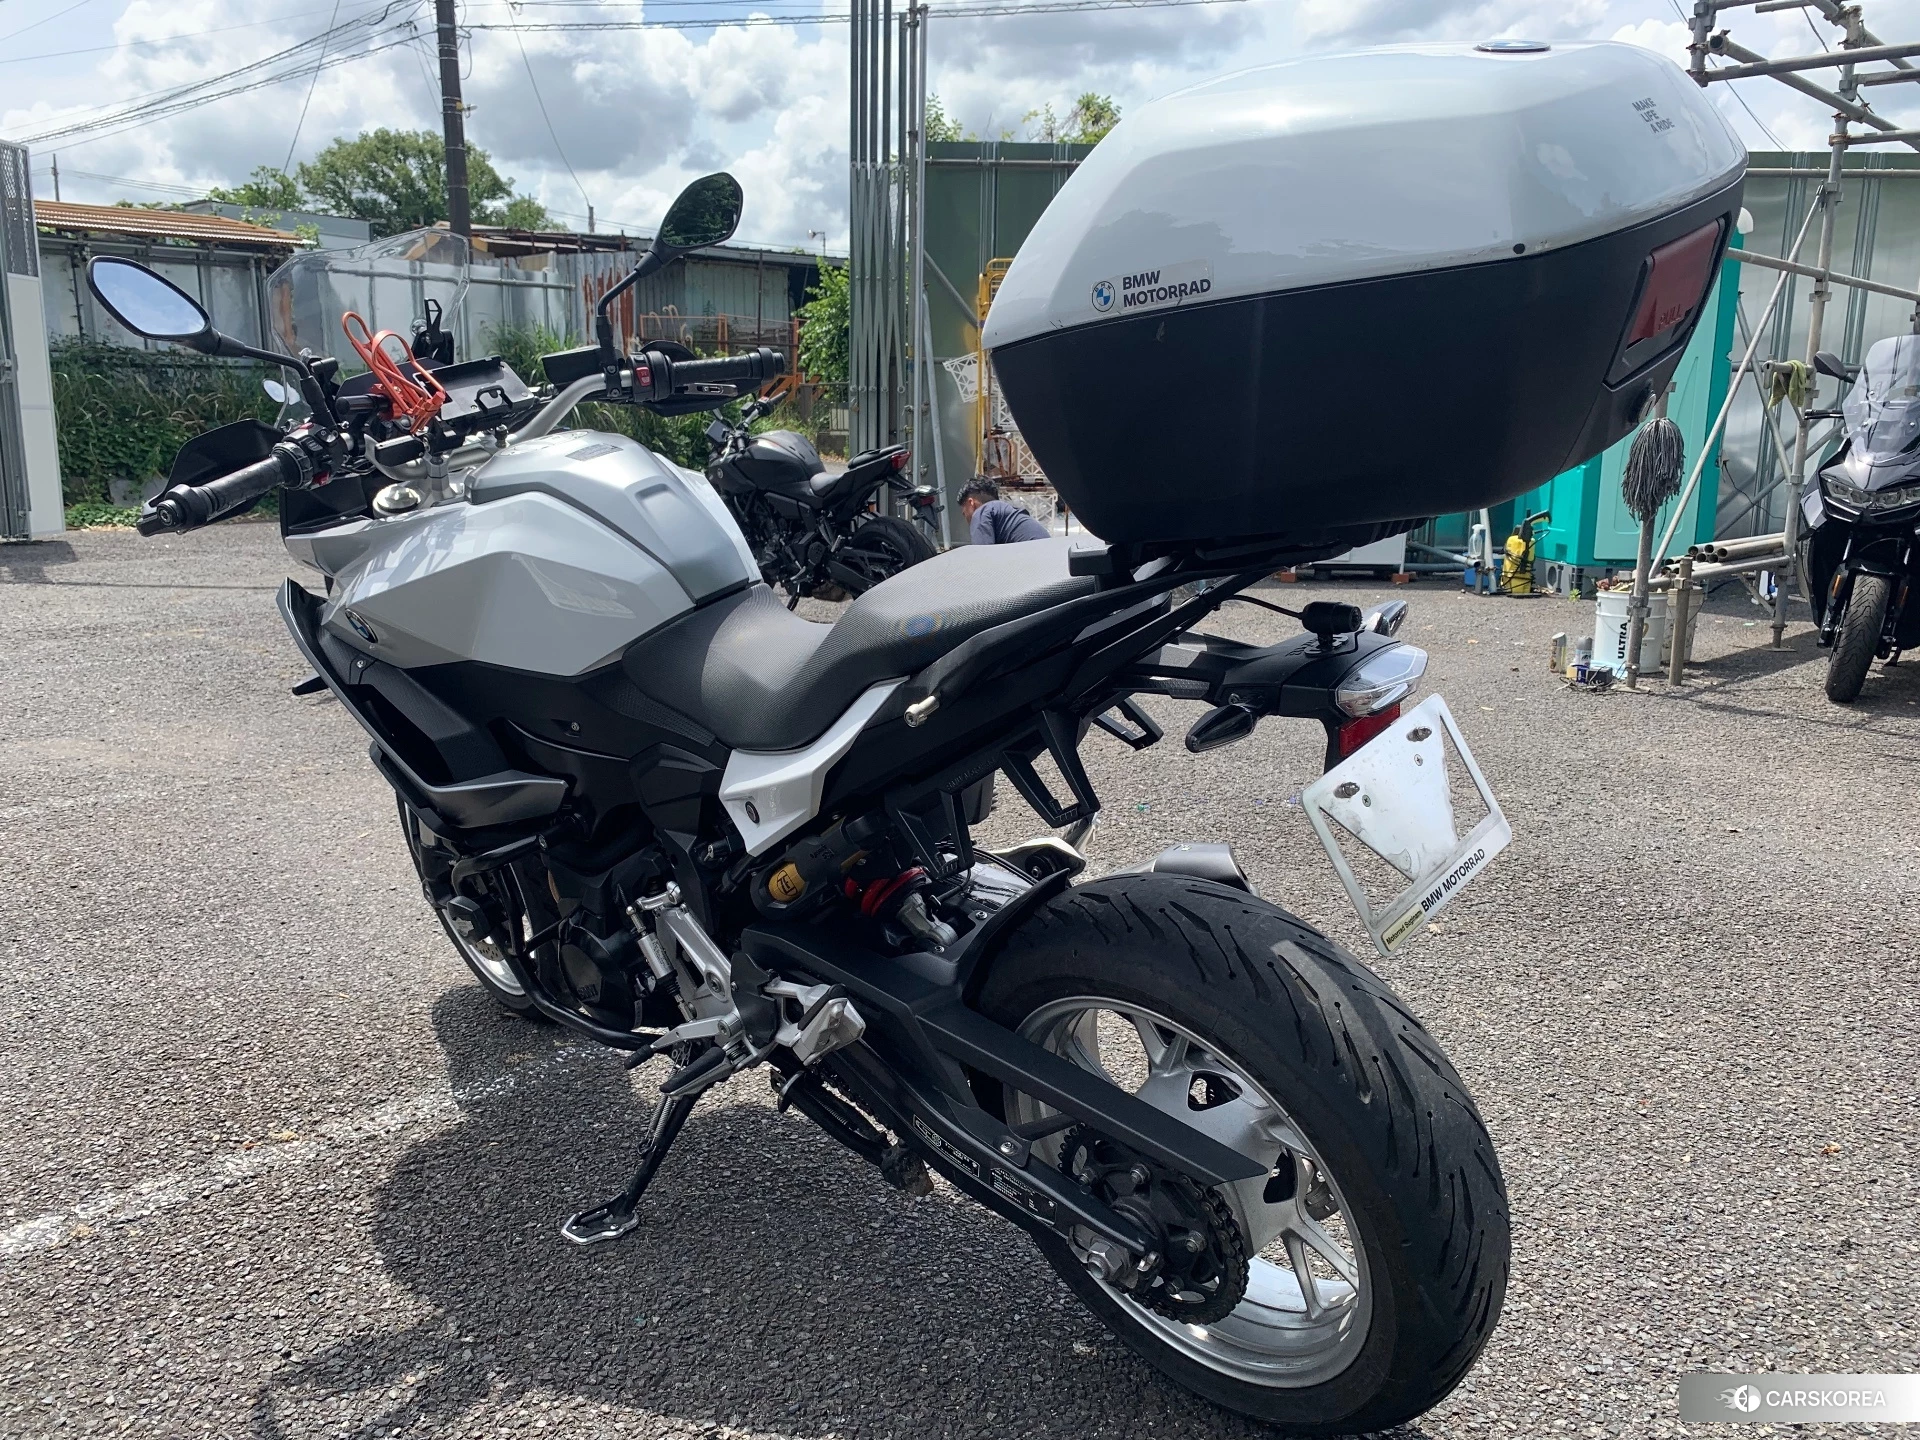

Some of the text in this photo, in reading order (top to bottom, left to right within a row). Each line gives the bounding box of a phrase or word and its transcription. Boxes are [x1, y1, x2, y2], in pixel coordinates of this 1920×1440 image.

[1631, 97, 1657, 112] MAKE
[1640, 109, 1660, 123] LIFE
[1650, 117, 1675, 134] A RIDE
[1122, 270, 1161, 291] BMW
[1123, 278, 1211, 308] MOTORRAD
[1617, 621, 1628, 659] ULTRA
[1420, 848, 1485, 913] BMW MOTORRAD
[1385, 925, 1405, 945] Motorrad
